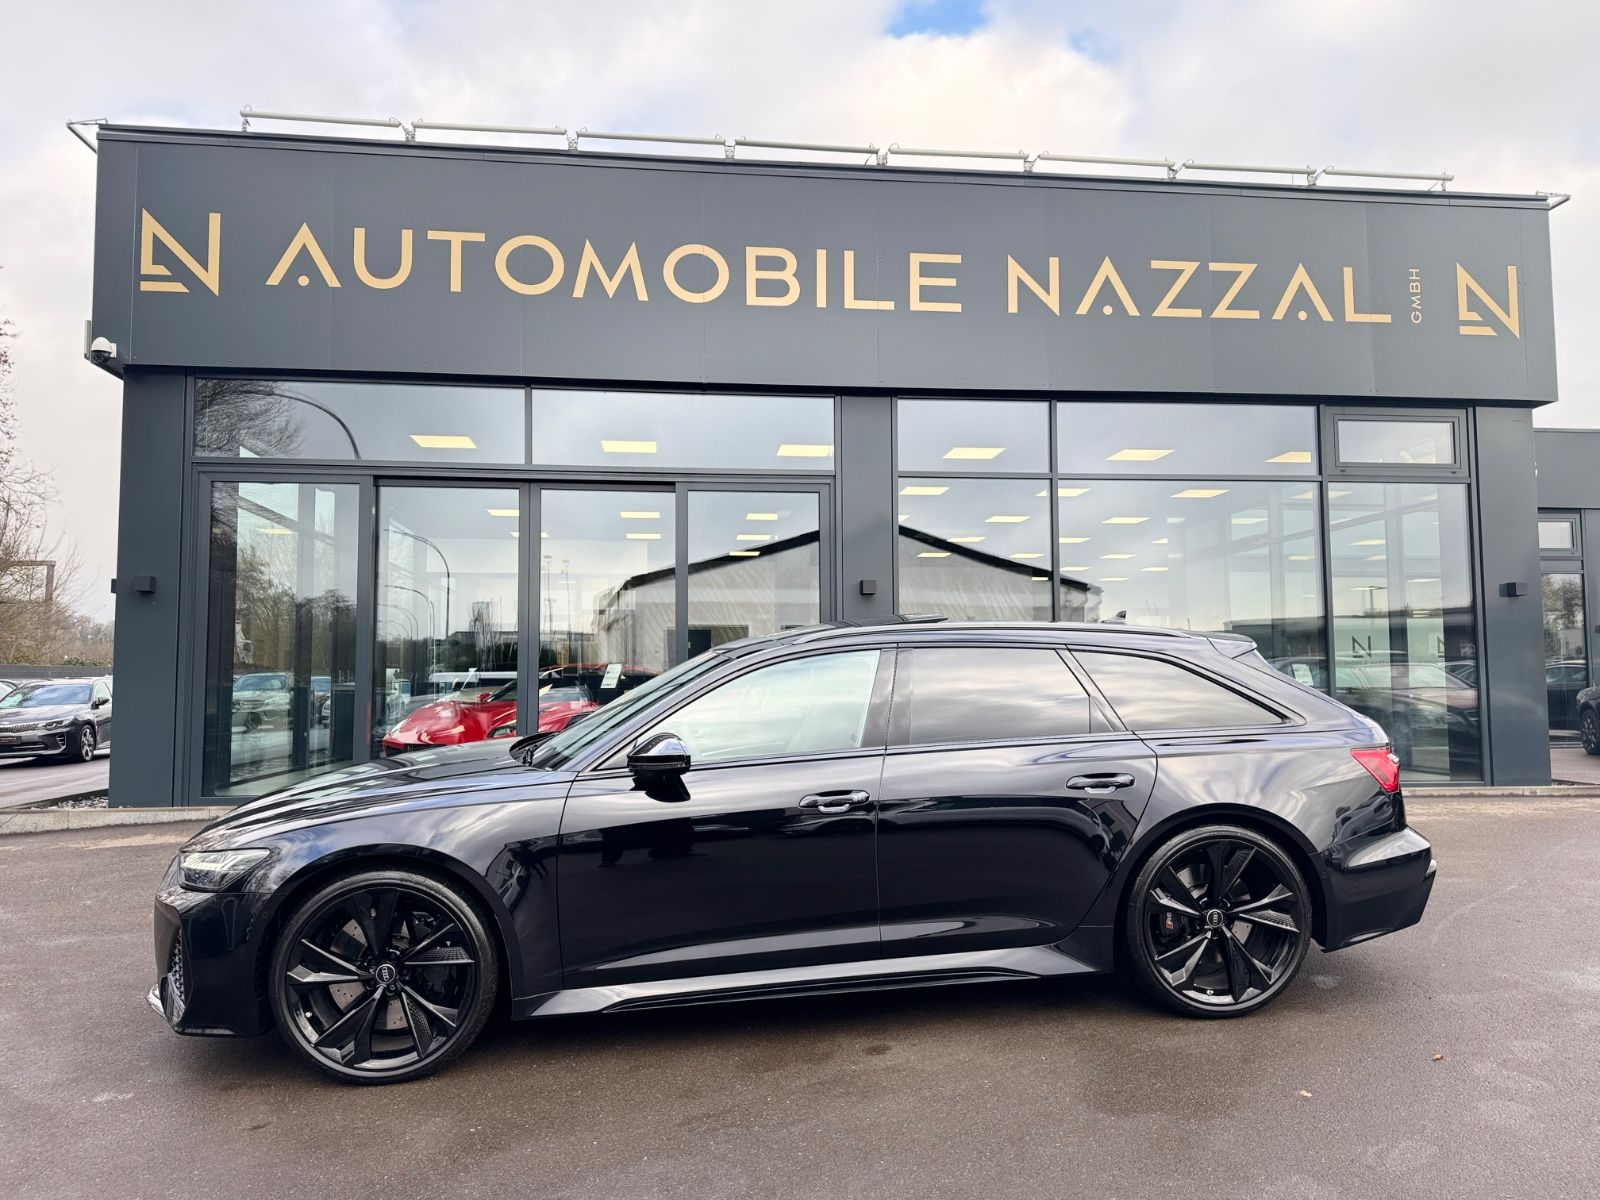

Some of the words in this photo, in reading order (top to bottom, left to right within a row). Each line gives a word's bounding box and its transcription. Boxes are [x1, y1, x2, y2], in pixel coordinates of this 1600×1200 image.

[265, 222, 963, 313] AUTOMOBILE
[1006, 254, 1392, 324] NAZZAL
[1408, 267, 1423, 325] GMBH
